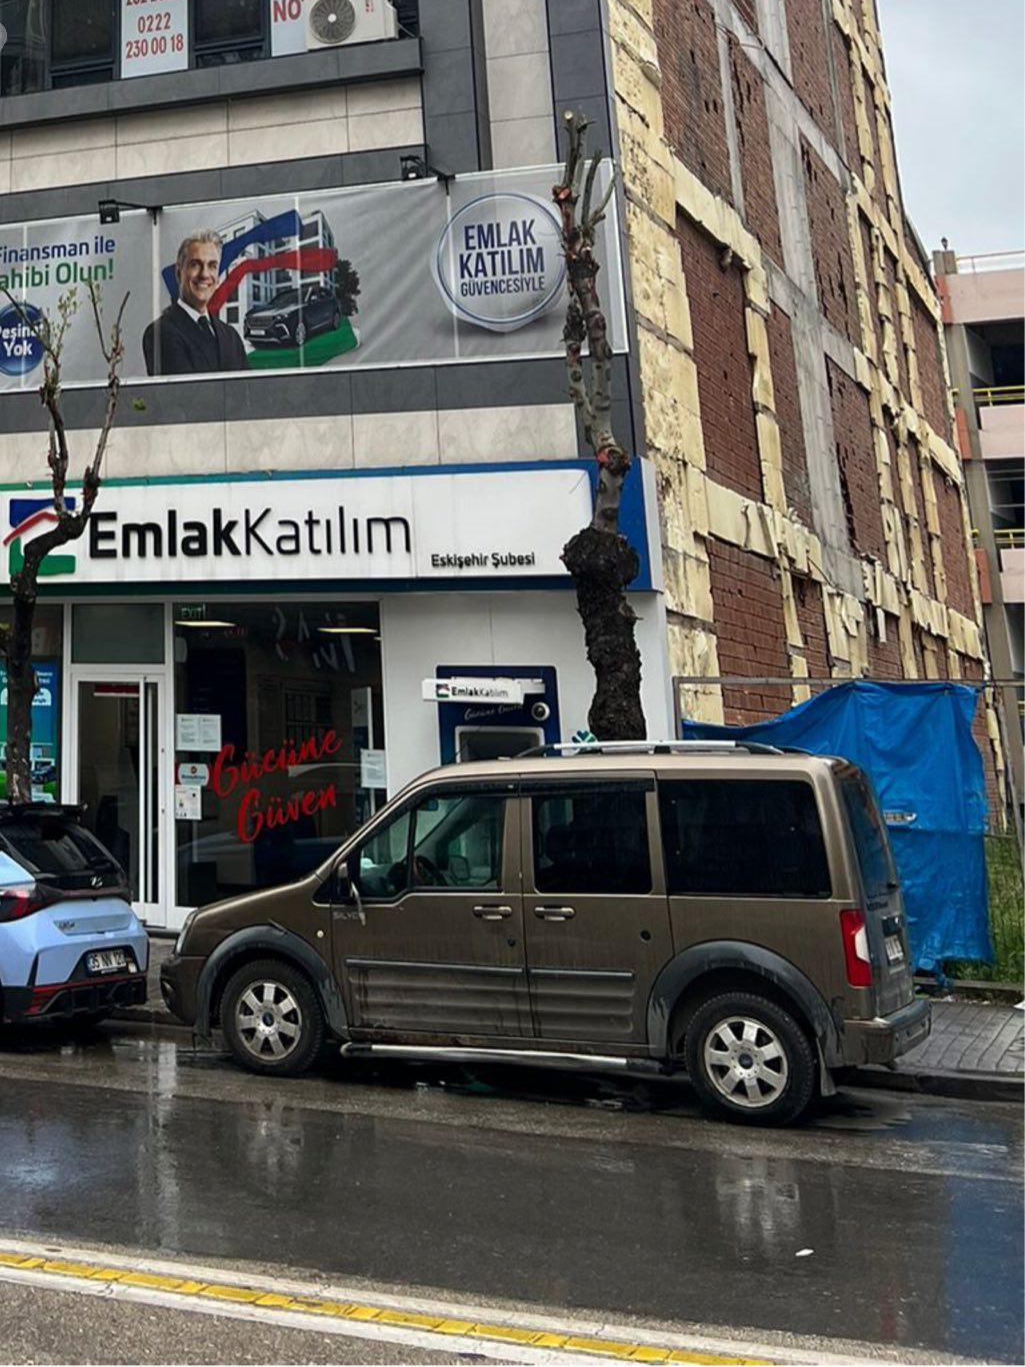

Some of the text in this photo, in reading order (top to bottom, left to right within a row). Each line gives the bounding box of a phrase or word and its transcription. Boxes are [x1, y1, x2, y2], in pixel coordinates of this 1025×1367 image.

[137, 12, 171, 34] 0222
[125, 33, 184, 60] 230 00 18
[94, 236, 116, 255] ile
[464, 219, 536, 250] EMLAK
[56, 259, 114, 284] Olun!
[459, 247, 545, 280] KATILIM
[460, 273, 546, 298] GÜVENCESİYLE
[2, 341, 33, 358] Yok
[89, 506, 411, 559] EmlakKatılım
[431, 551, 535, 569] Eskişehir Şubesi
[237, 785, 337, 843] Güven
